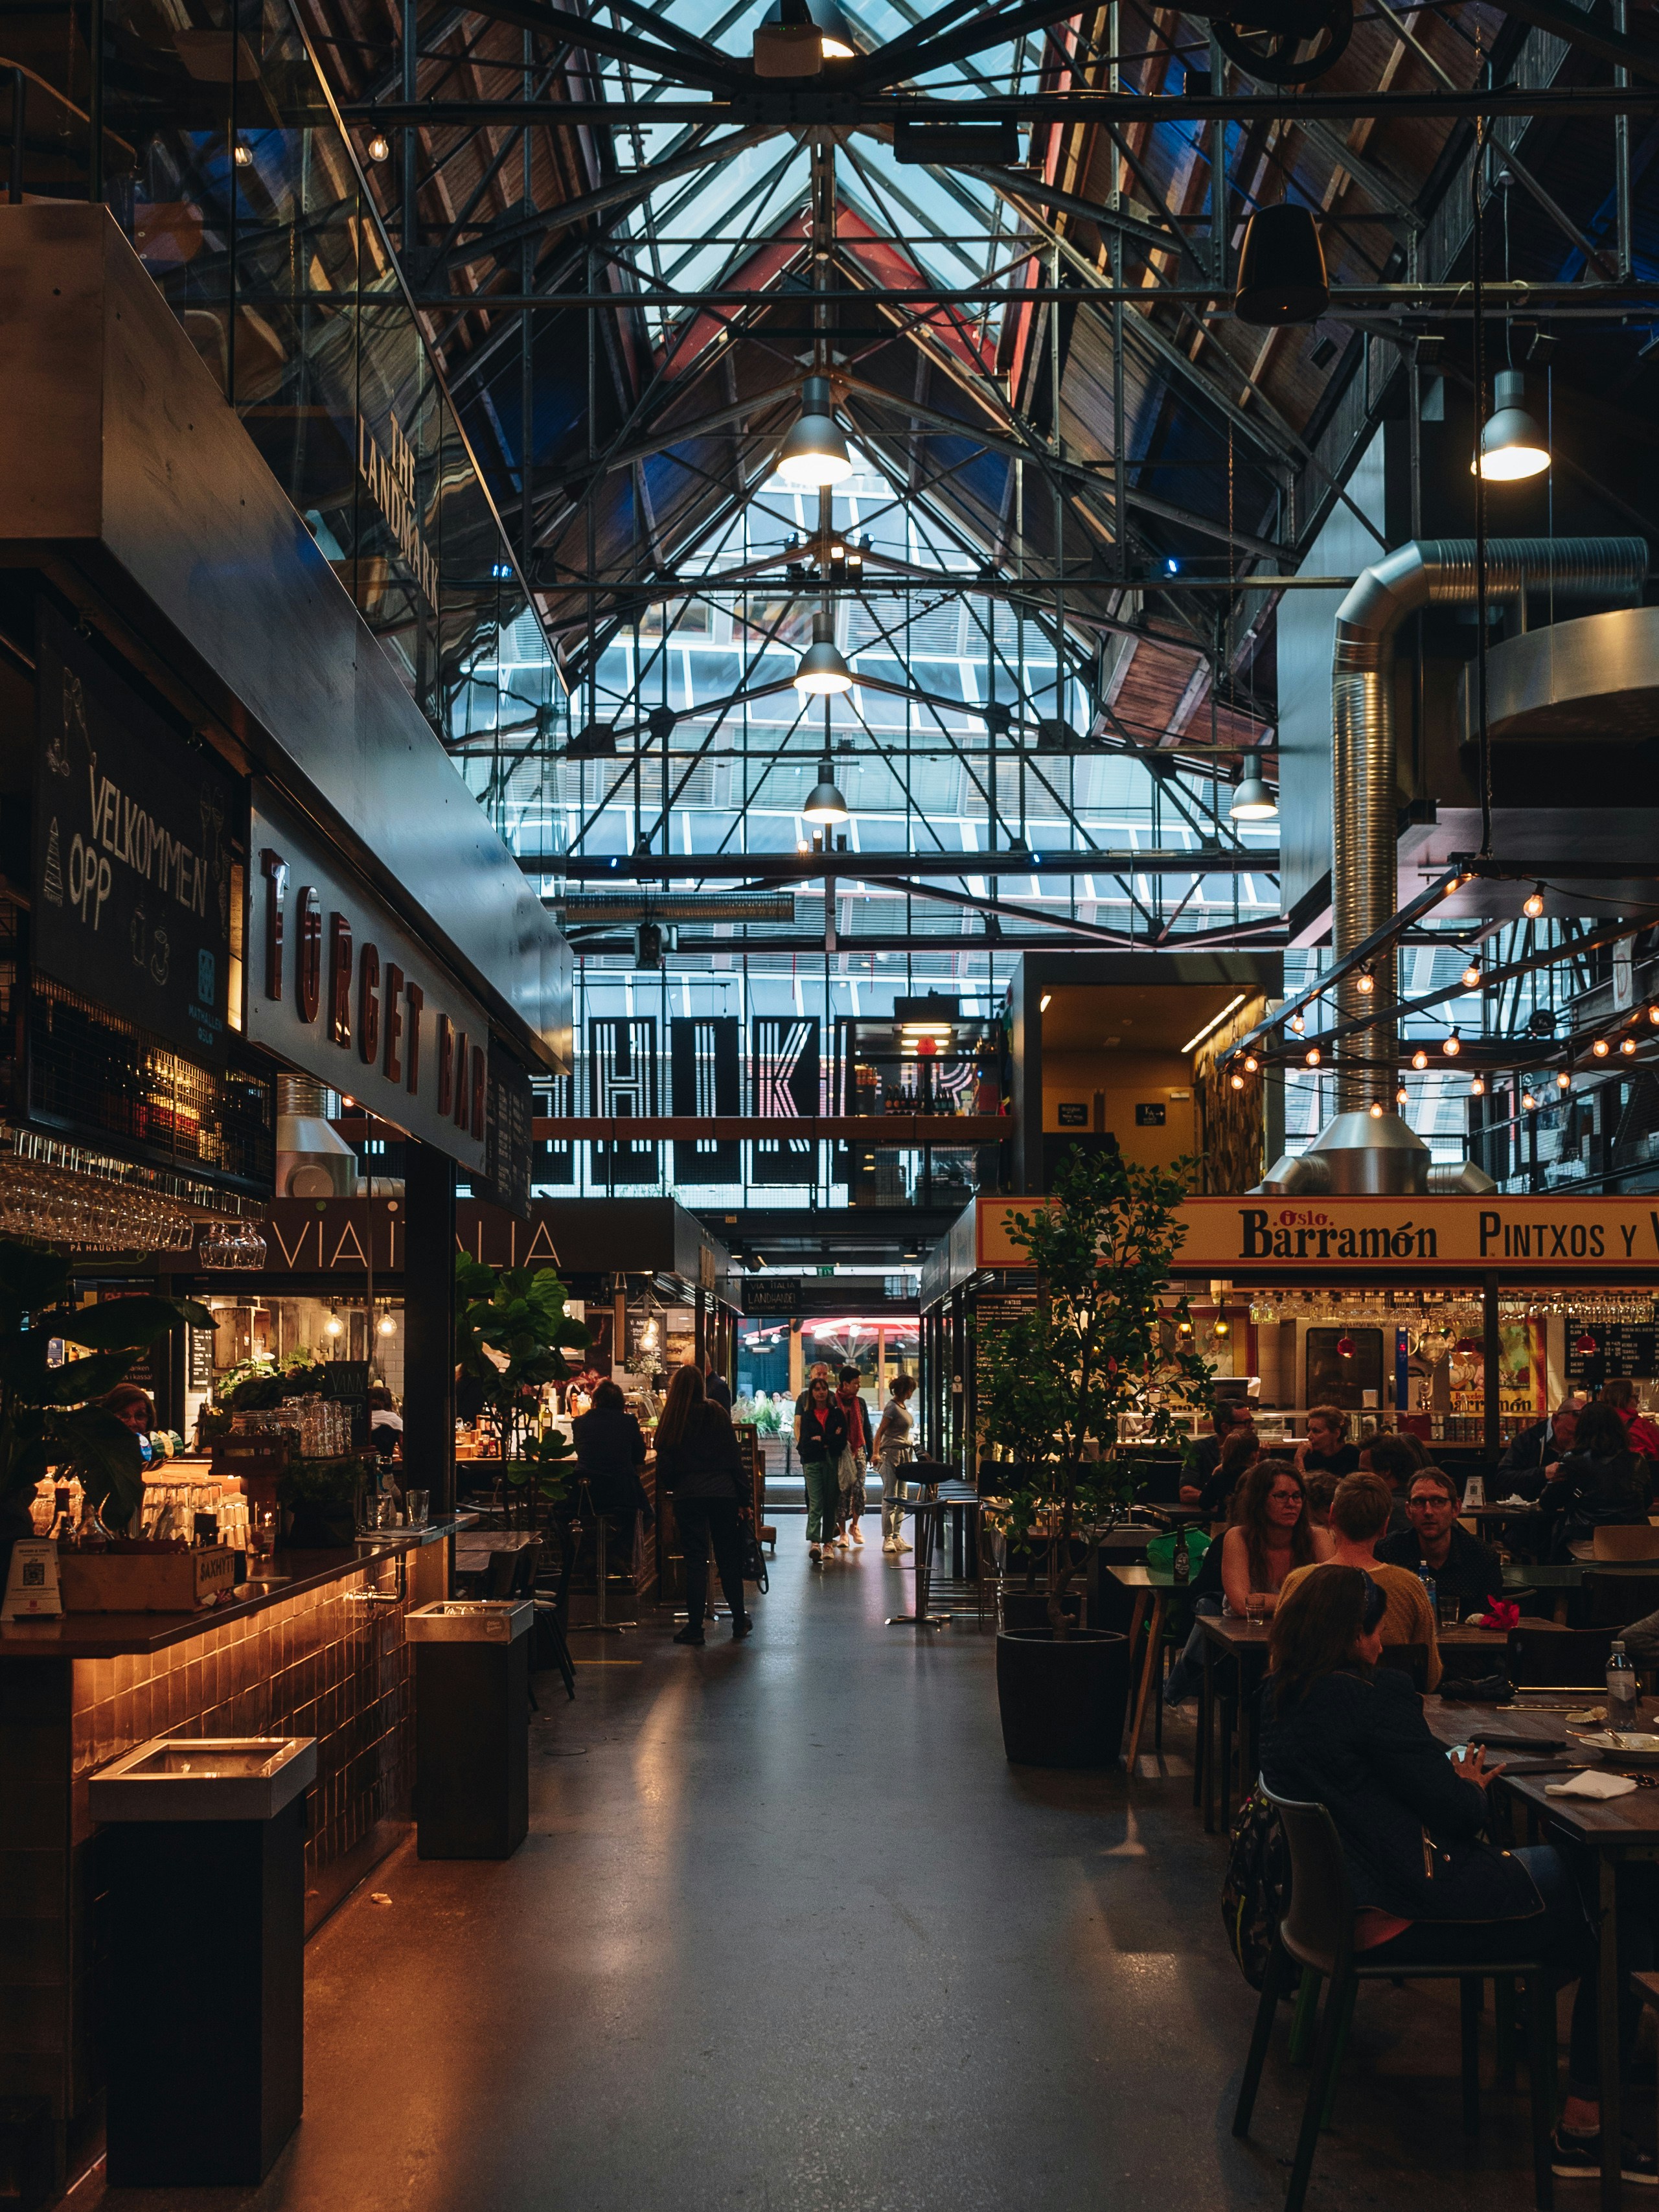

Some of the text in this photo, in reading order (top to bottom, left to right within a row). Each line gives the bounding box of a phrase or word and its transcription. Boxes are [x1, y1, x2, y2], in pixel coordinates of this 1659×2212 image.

[390, 410, 415, 510] THE
[360, 414, 439, 616] LANDMARK
[89, 764, 208, 919] VELKOMMEN
[69, 833, 112, 931] OPP
[261, 848, 488, 1143] TORGET BAR
[70, 1241, 82, 1251] PÅ
[272, 1220, 369, 1269] VIA
[1238, 1209, 1439, 1258] Barramón
[1480, 1211, 1605, 1257] PINTXOS
[1621, 1224, 1638, 1257] Y
[330, 1368, 365, 1393] VANN
